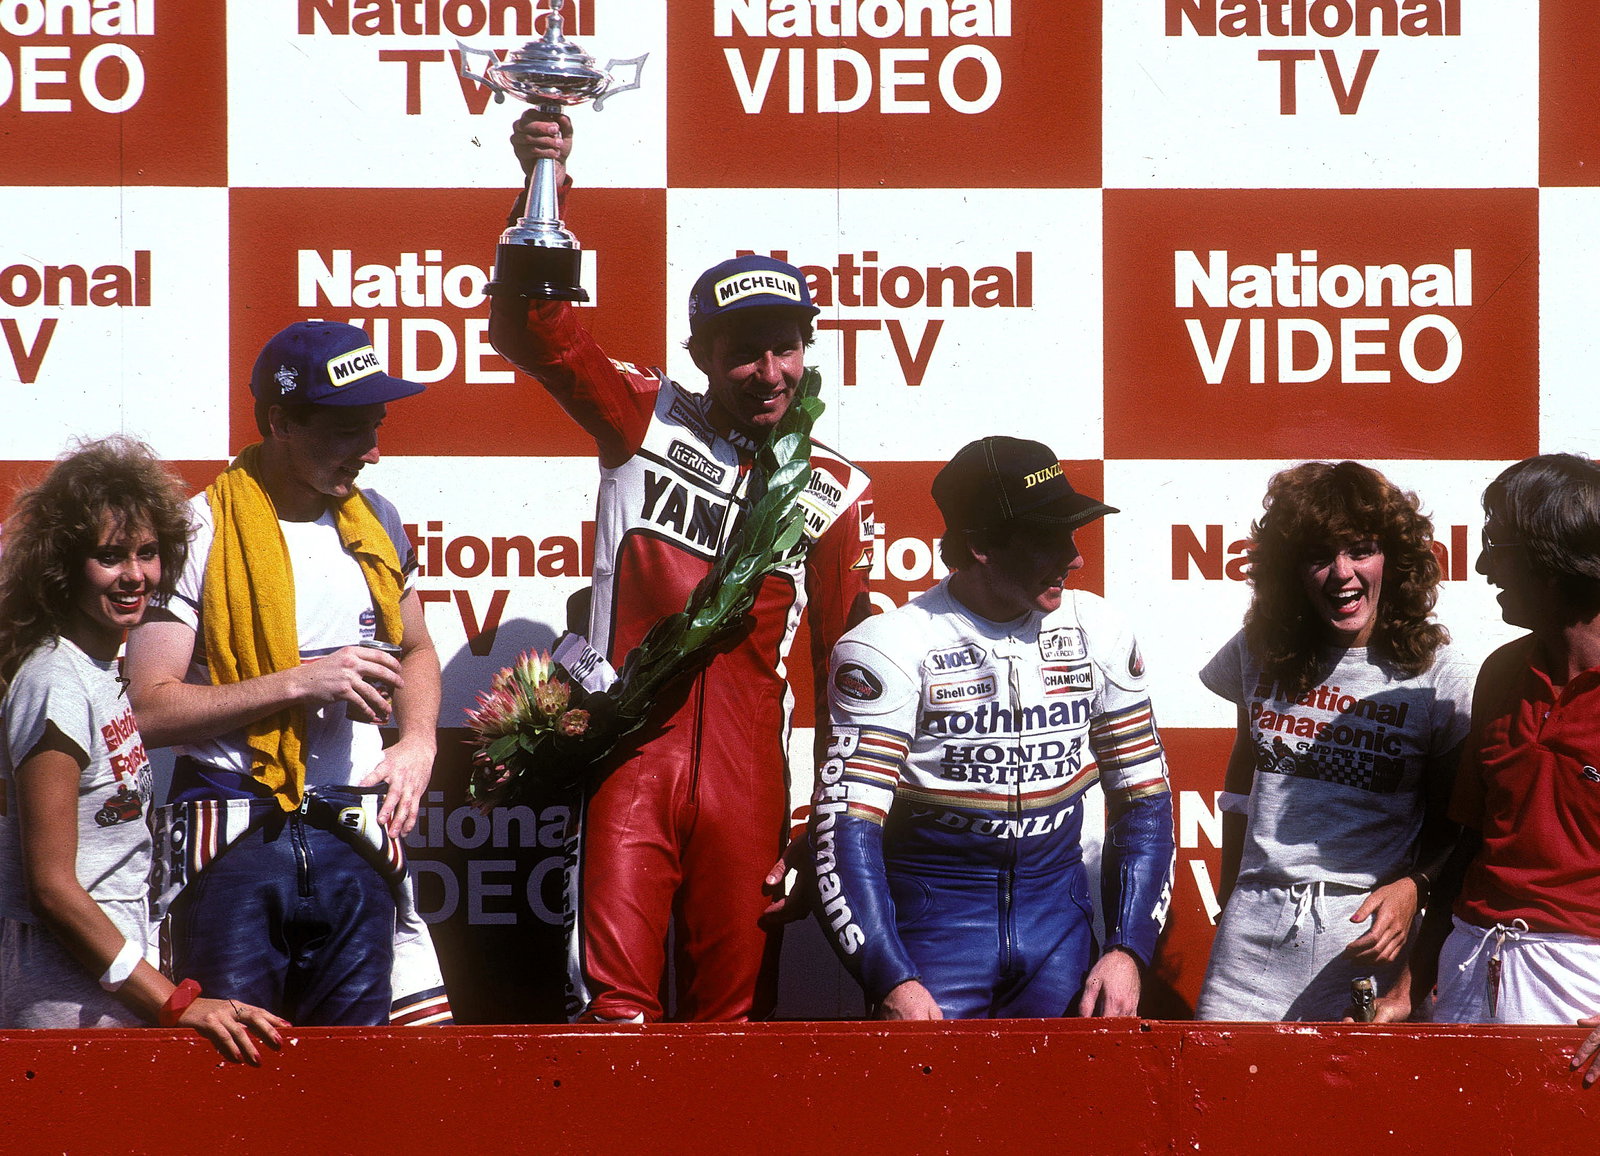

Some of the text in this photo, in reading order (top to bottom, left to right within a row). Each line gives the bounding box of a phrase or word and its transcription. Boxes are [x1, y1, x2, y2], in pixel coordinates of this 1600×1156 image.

[0, 0, 155, 36] onal
[298, 0, 596, 37] National
[713, 0, 1012, 38] National
[1165, 0, 1461, 38] National
[723, 44, 1002, 114] VIDEO
[1258, 49, 1380, 115] TV
[0, 250, 151, 307] onal
[298, 249, 597, 308] Natiol
[719, 276, 797, 301] MICHELIN
[735, 250, 1032, 309] ational
[1174, 248, 1472, 308] National
[0, 318, 59, 384] V
[307, 318, 515, 384] IDE
[332, 352, 380, 380] MICHE
[816, 319, 945, 386] TV
[1184, 313, 1463, 385] VIDEO
[671, 444, 722, 483] KERKER
[808, 470, 842, 502] lboro
[1023, 462, 1064, 489] DUNL
[641, 469, 746, 552] YAM
[402, 520, 597, 578] tional
[933, 646, 978, 671] SHOEI
[1044, 672, 1092, 687] CHAMPION
[935, 682, 992, 701] Shell Oils
[920, 697, 1105, 735] othman
[1251, 701, 1402, 755] Panasonic
[940, 751, 1083, 787] BRITAIN
[941, 737, 1083, 767] HONDA
[813, 725, 867, 956] Rothmans
[407, 855, 566, 926] DEO
